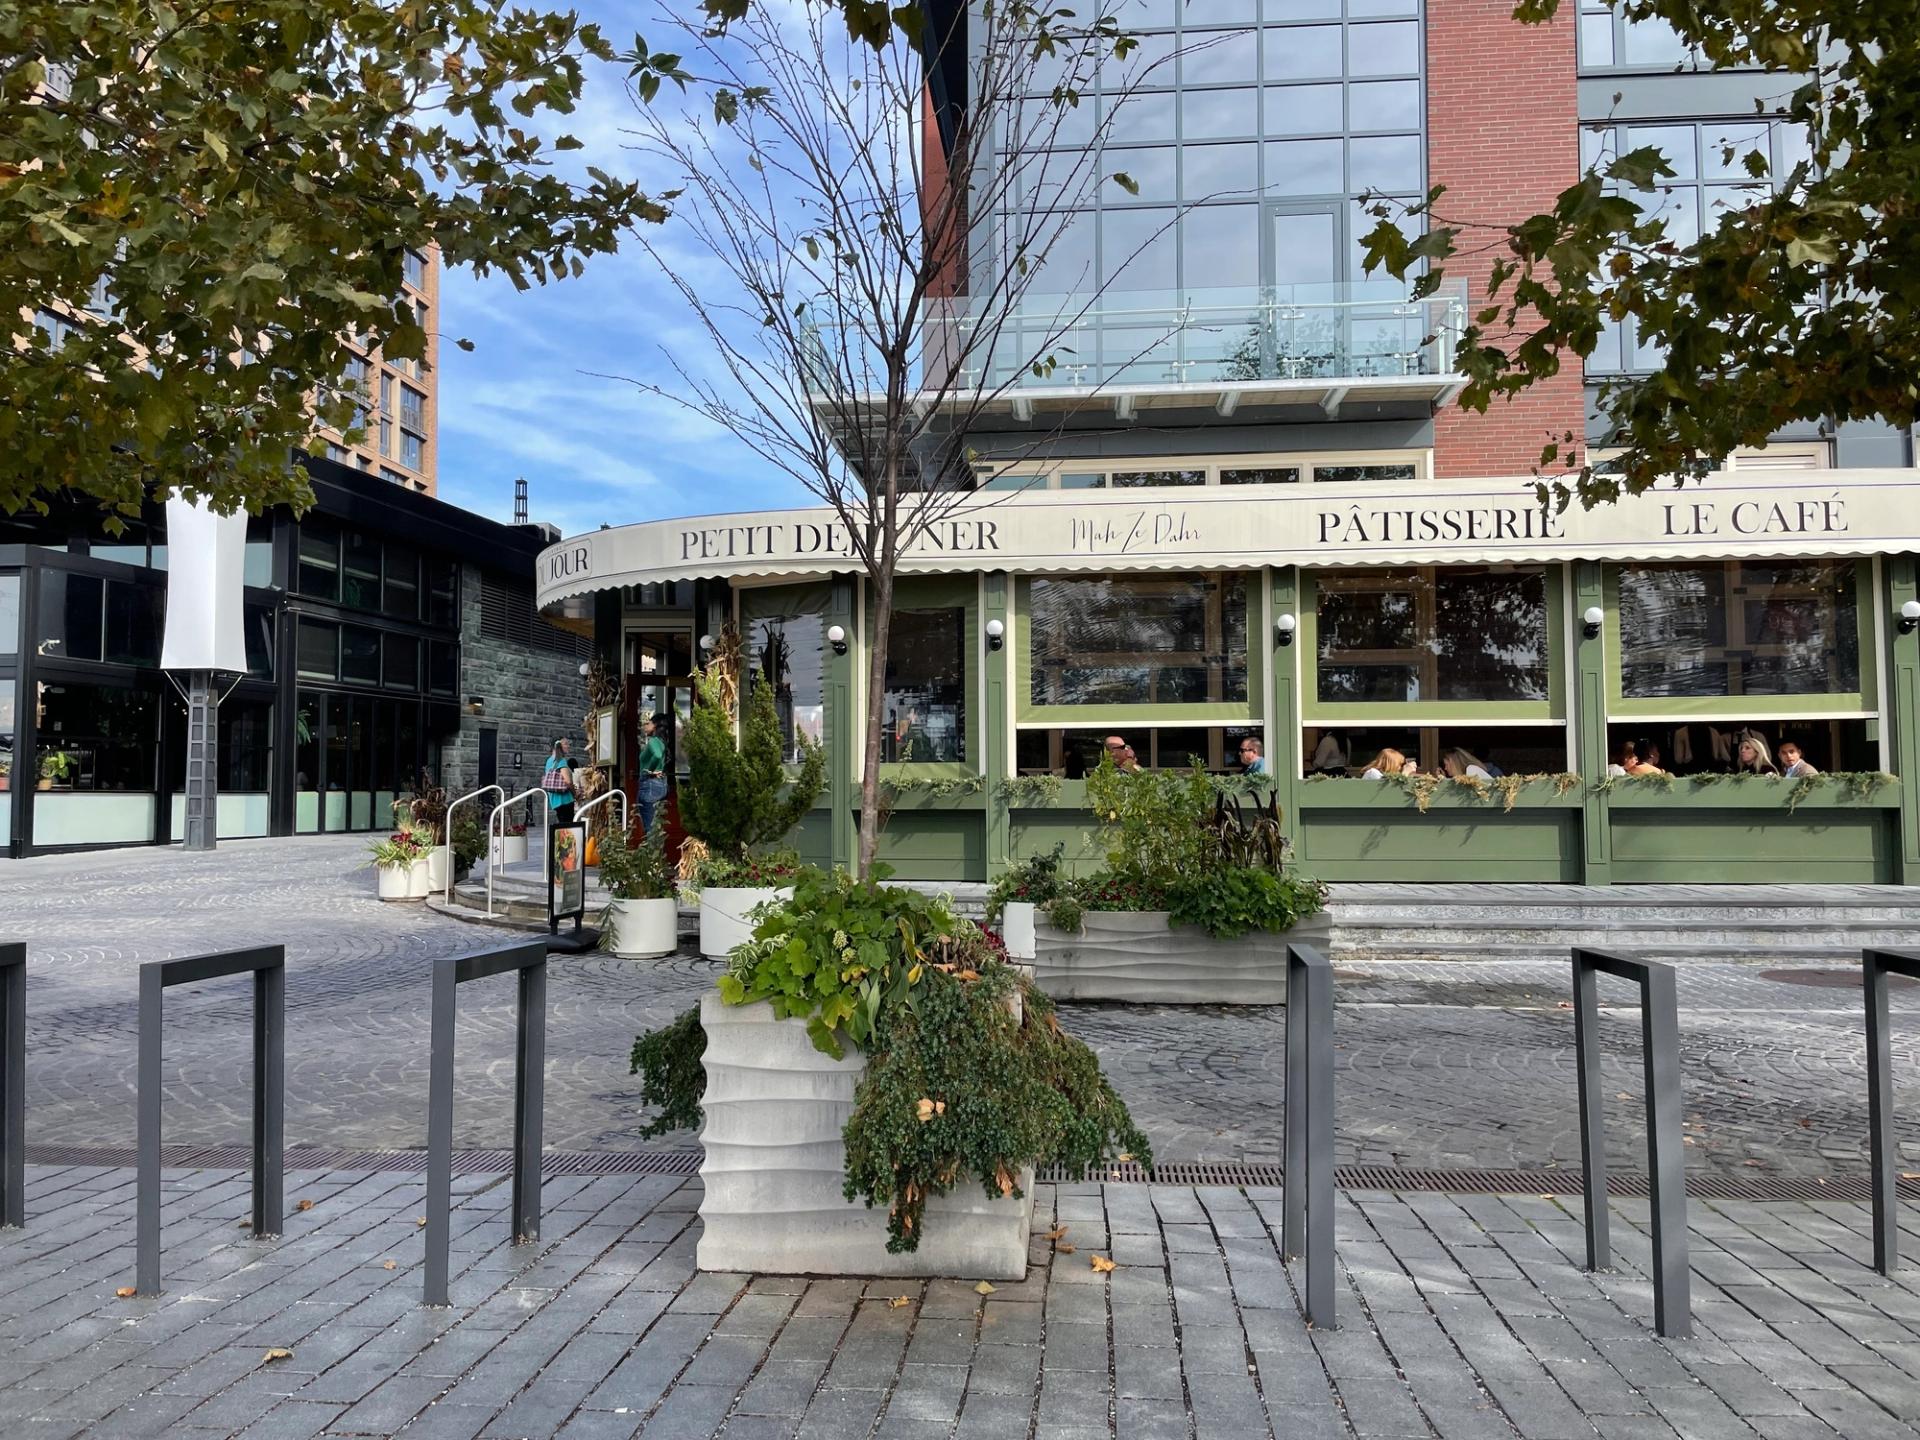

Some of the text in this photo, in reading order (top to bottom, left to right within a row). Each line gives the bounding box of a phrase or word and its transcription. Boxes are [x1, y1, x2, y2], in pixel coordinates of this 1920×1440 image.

[1070, 518, 1122, 552] Mah
[1154, 511, 1201, 545] Dahr
[1318, 505, 1566, 543] PÂTISSERIE
[1663, 491, 1849, 536] LE CAFÉ
[681, 514, 1000, 560] PETIT DÉJNER
[550, 548, 588, 582] JOUR
